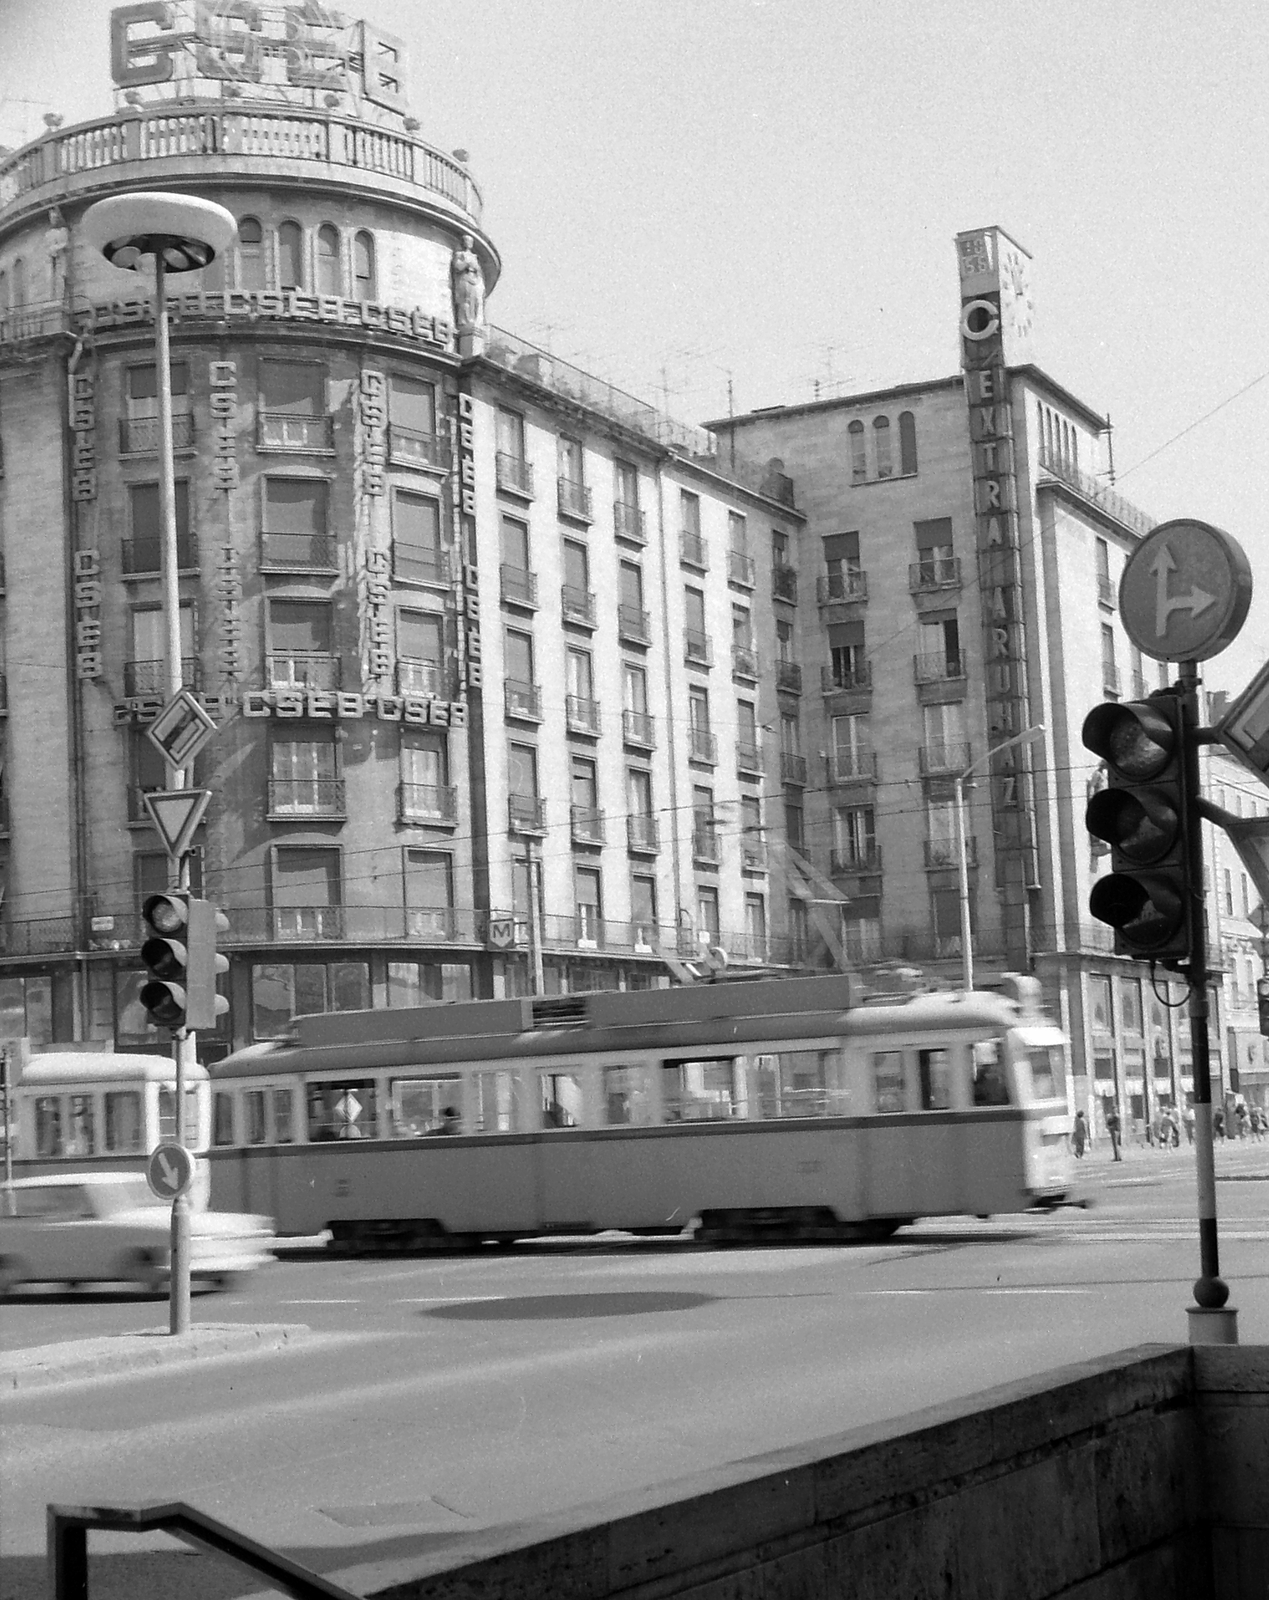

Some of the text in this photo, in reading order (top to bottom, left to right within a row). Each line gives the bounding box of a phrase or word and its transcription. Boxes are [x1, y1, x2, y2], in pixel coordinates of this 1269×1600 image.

[361, 300, 450, 344] CSÉB
[979, 371, 1003, 546] EXTRA
[493, 923, 510, 939] M
